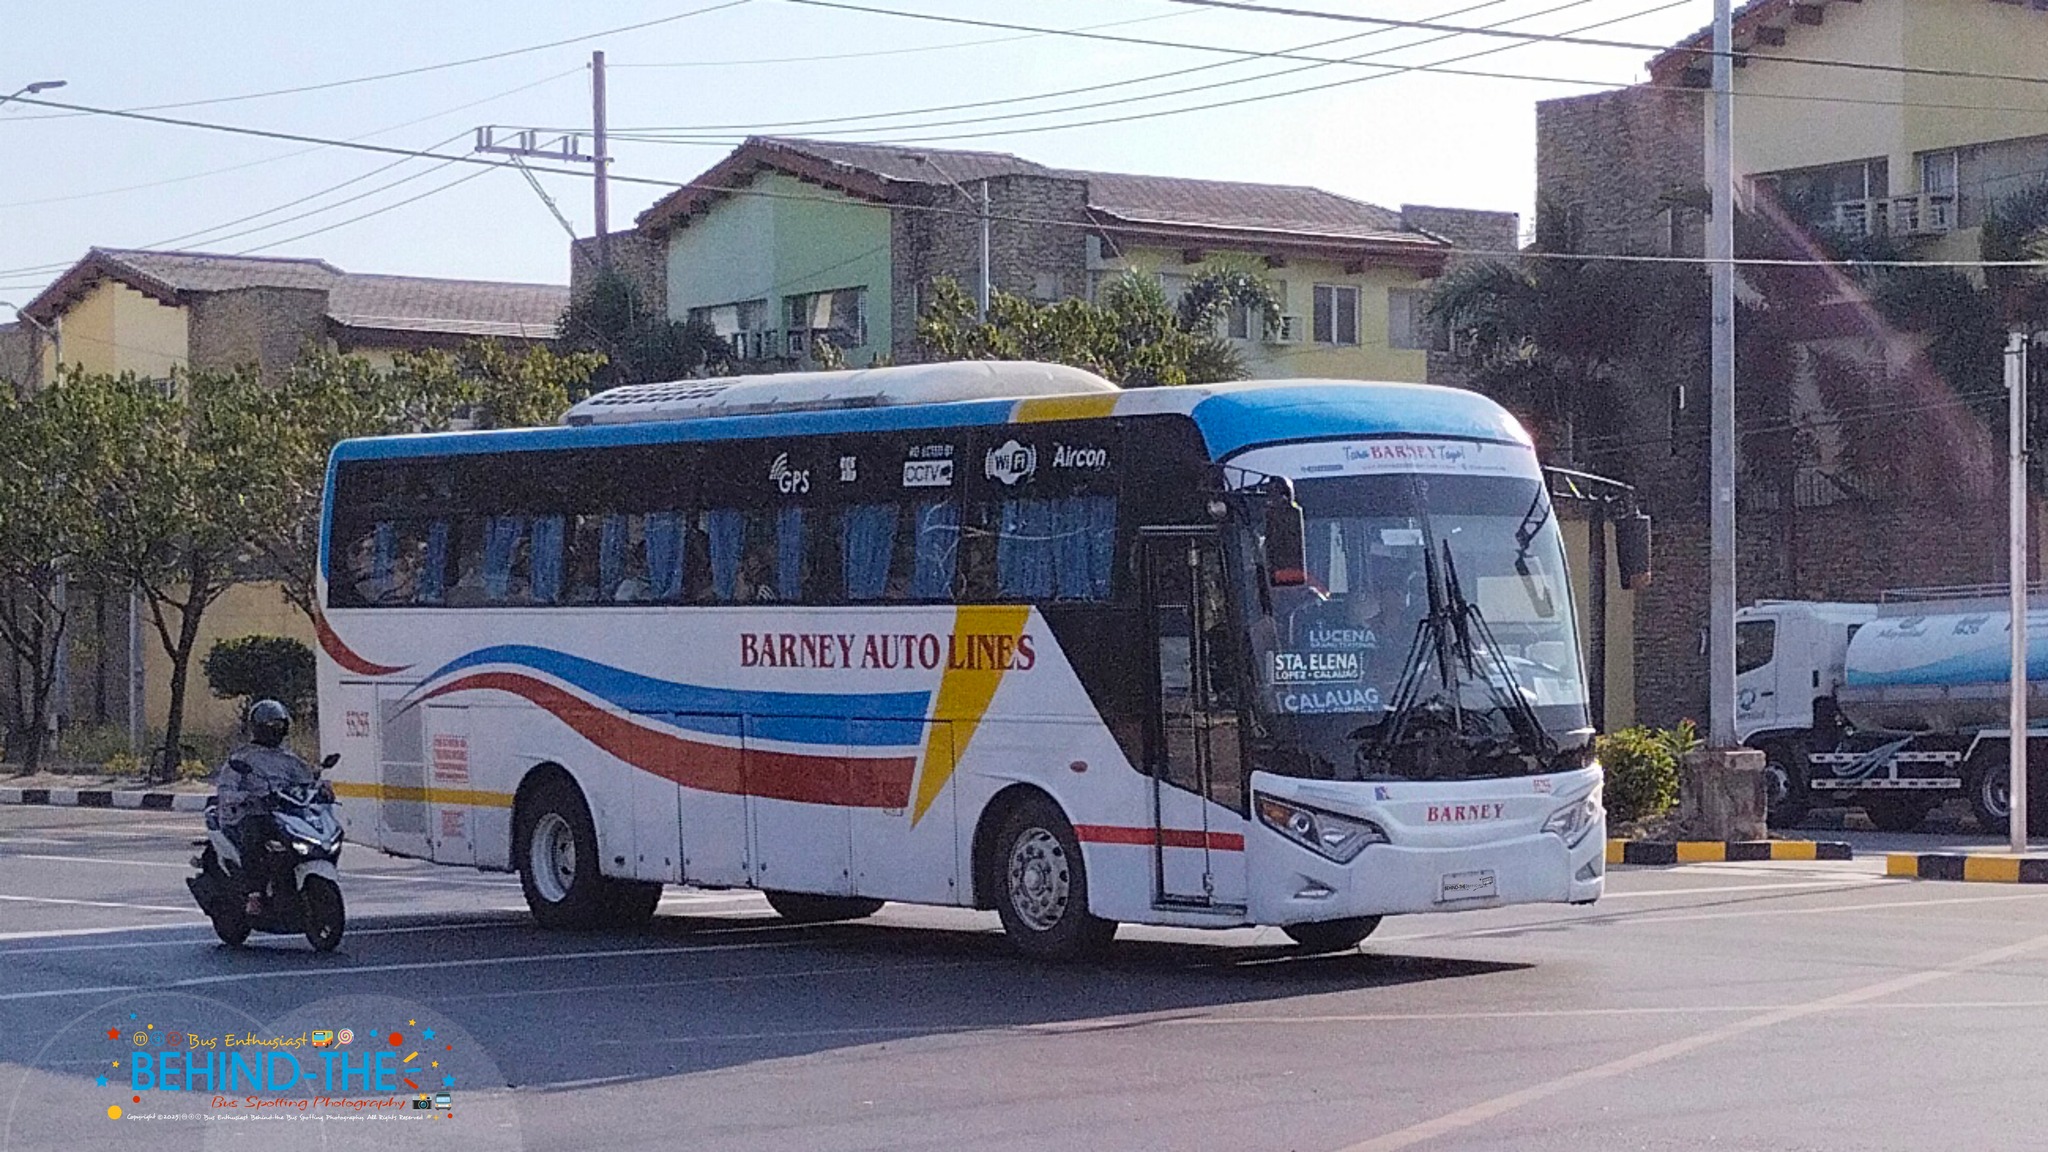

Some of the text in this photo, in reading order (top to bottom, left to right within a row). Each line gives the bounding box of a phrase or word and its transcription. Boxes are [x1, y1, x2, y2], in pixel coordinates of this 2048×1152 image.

[1053, 446, 1106, 468] Aircon
[779, 469, 810, 493] GPS
[906, 465, 939, 482] CCTV
[1309, 629, 1376, 642] LUCENA
[741, 633, 1036, 671] BARNEY AUTO LINES
[1275, 653, 1358, 671] STA. ELENA
[1284, 687, 1379, 712] CALAUAG
[1427, 803, 1505, 822] BARNEY
